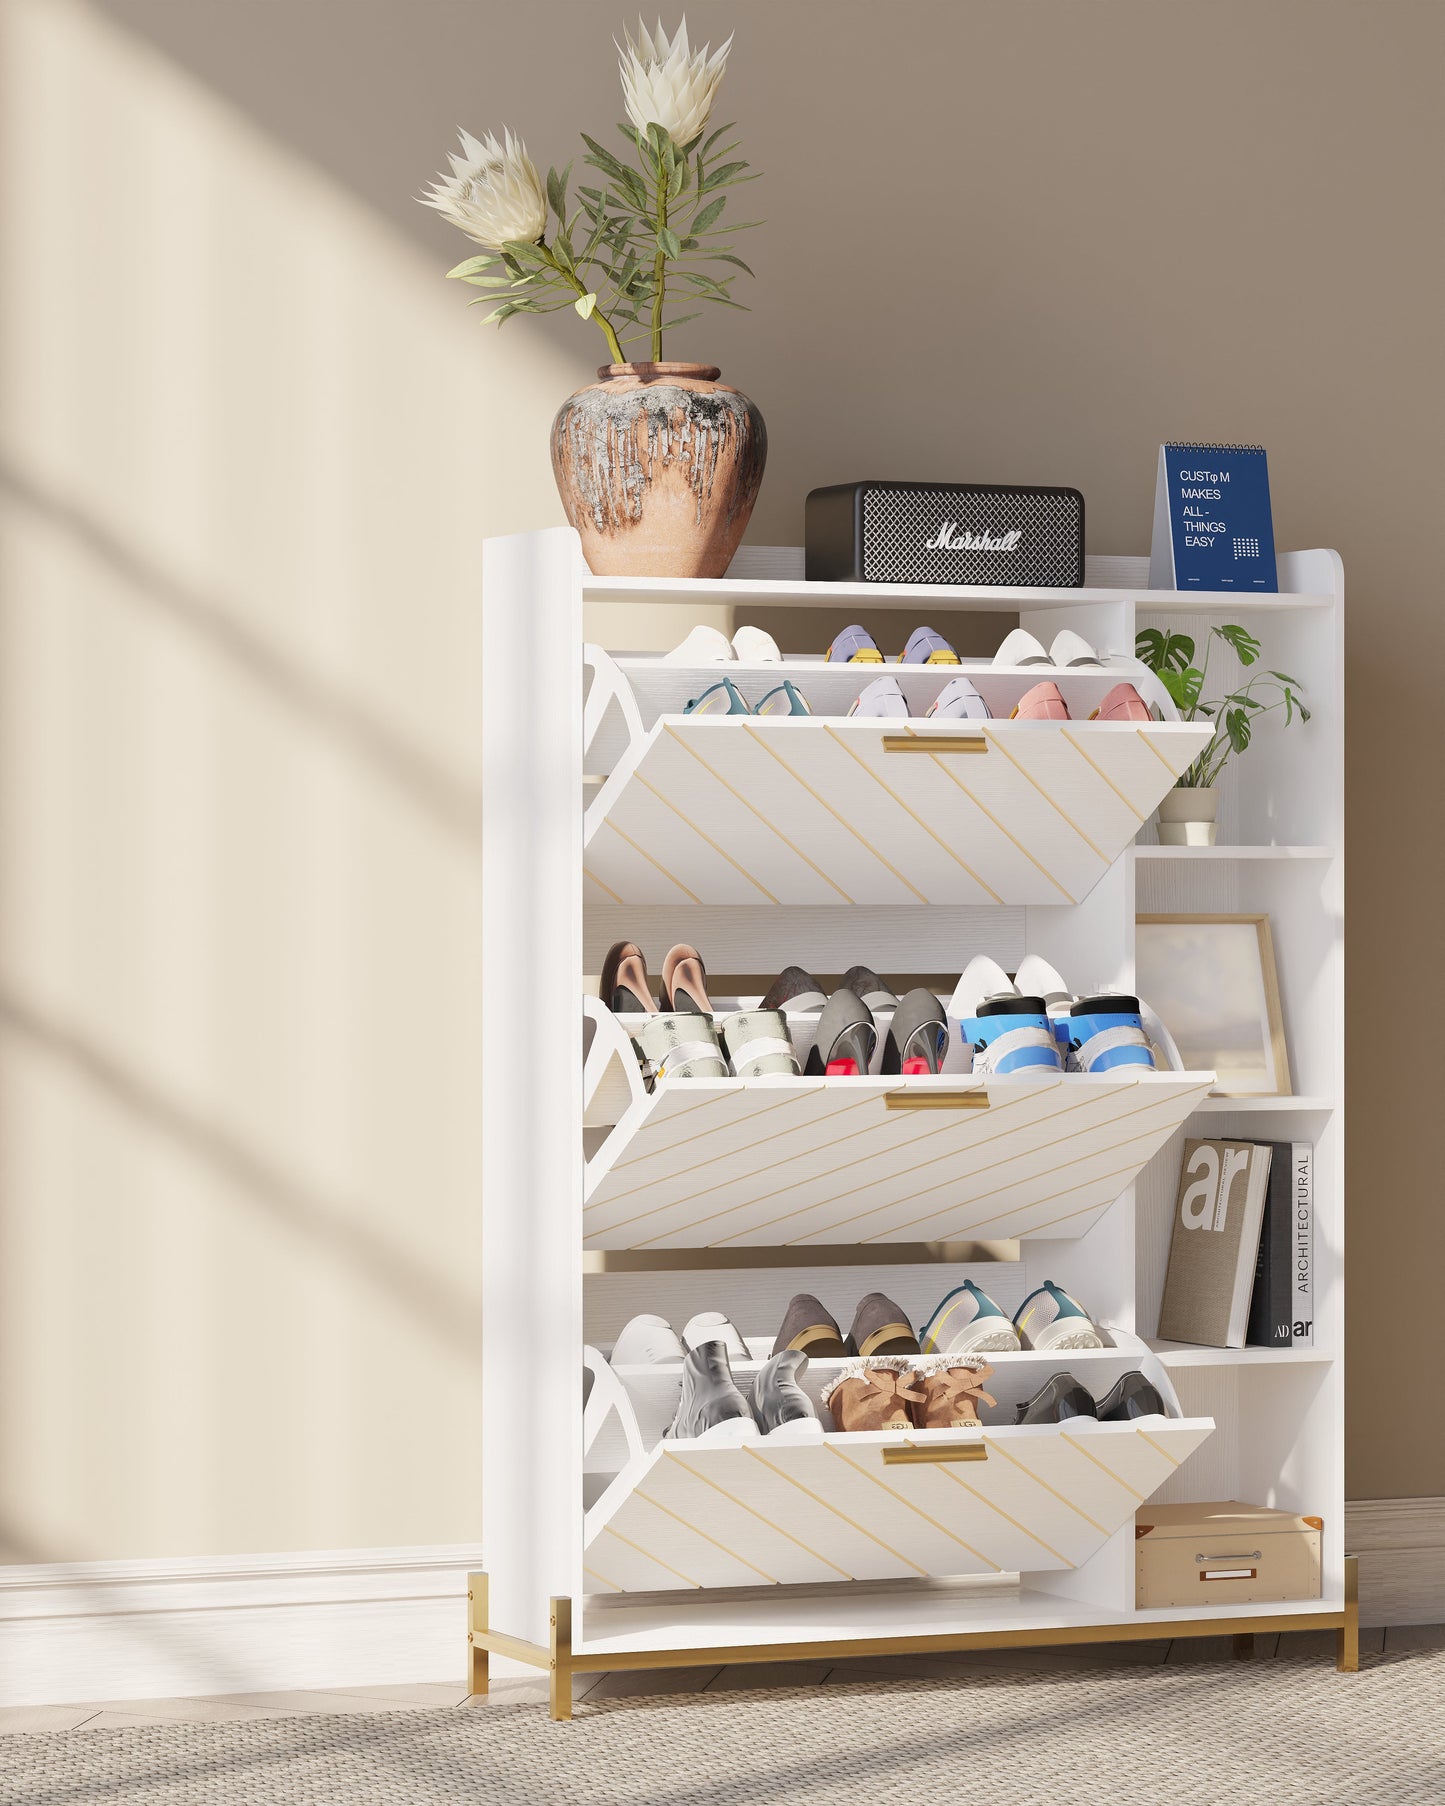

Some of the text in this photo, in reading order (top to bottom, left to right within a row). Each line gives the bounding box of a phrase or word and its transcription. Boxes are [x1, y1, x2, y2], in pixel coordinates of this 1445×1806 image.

[1181, 488, 1221, 500] MAKES
[1183, 521, 1226, 533] THINGS
[926, 521, 1022, 552] Marshall
[1185, 536, 1215, 547] EASY
[1181, 1145, 1249, 1232] ar
[1297, 1155, 1309, 1293] ARCHITECTURAL
[1274, 1324, 1290, 1338] AD
[1292, 1320, 1313, 1337] ar
